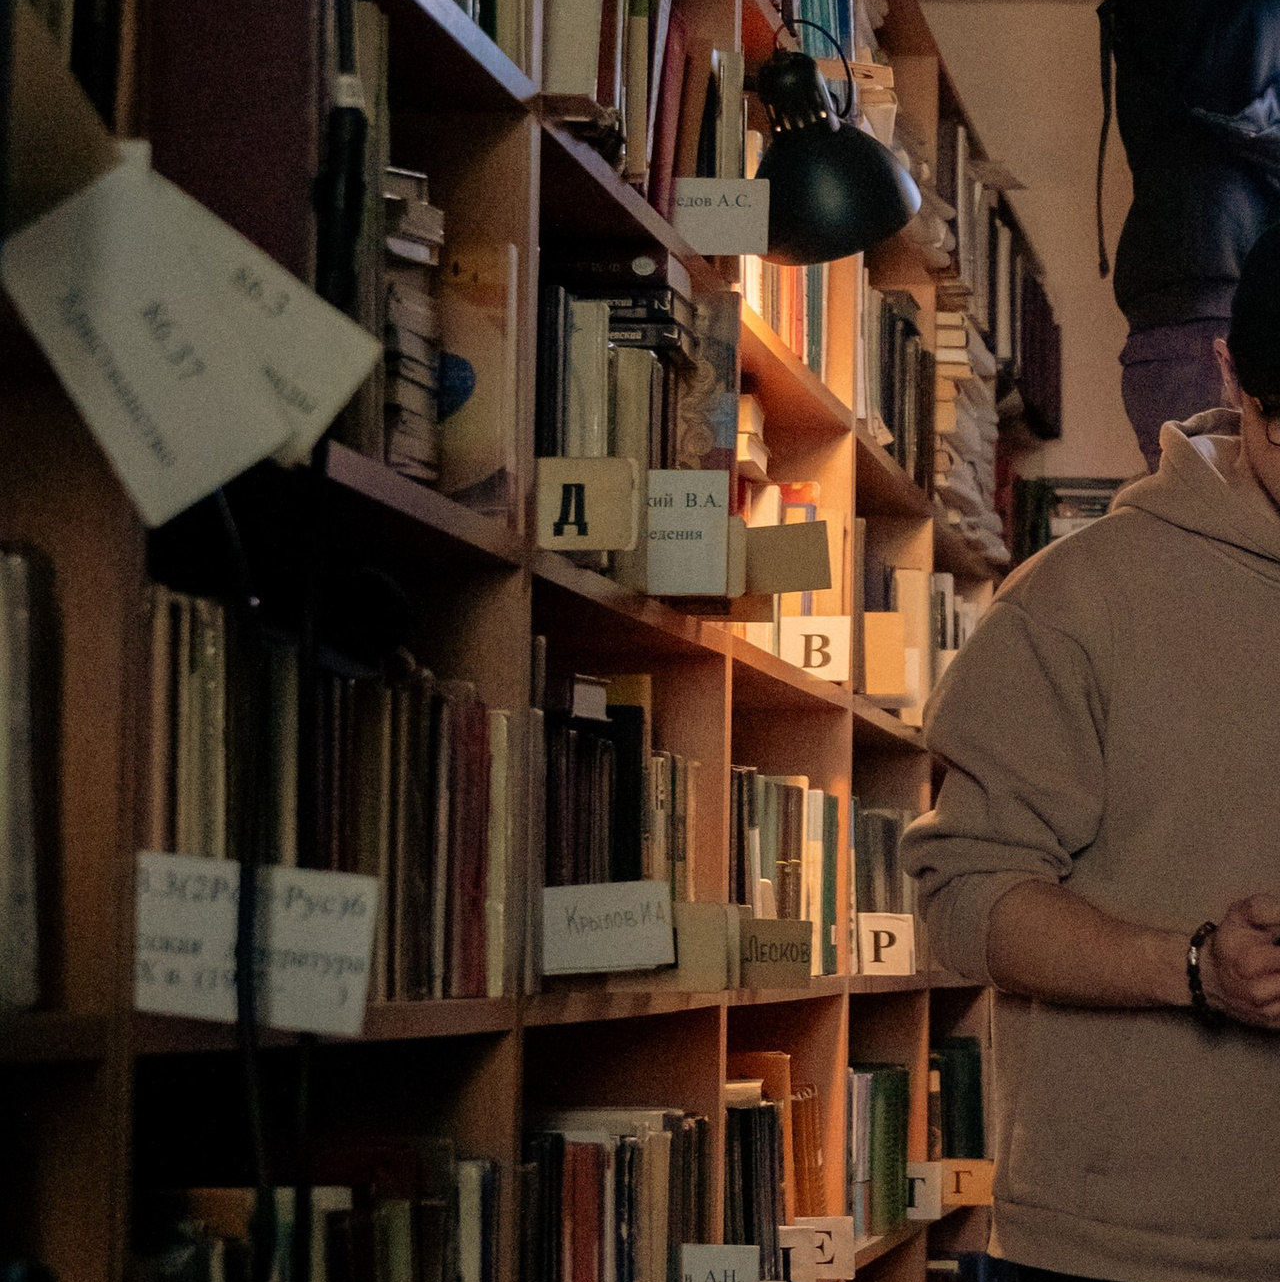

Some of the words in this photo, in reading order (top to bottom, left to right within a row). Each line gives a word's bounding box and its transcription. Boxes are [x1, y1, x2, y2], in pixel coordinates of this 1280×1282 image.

[553, 483, 589, 536] Д
[801, 633, 832, 668] В
[869, 929, 897, 963] Р
